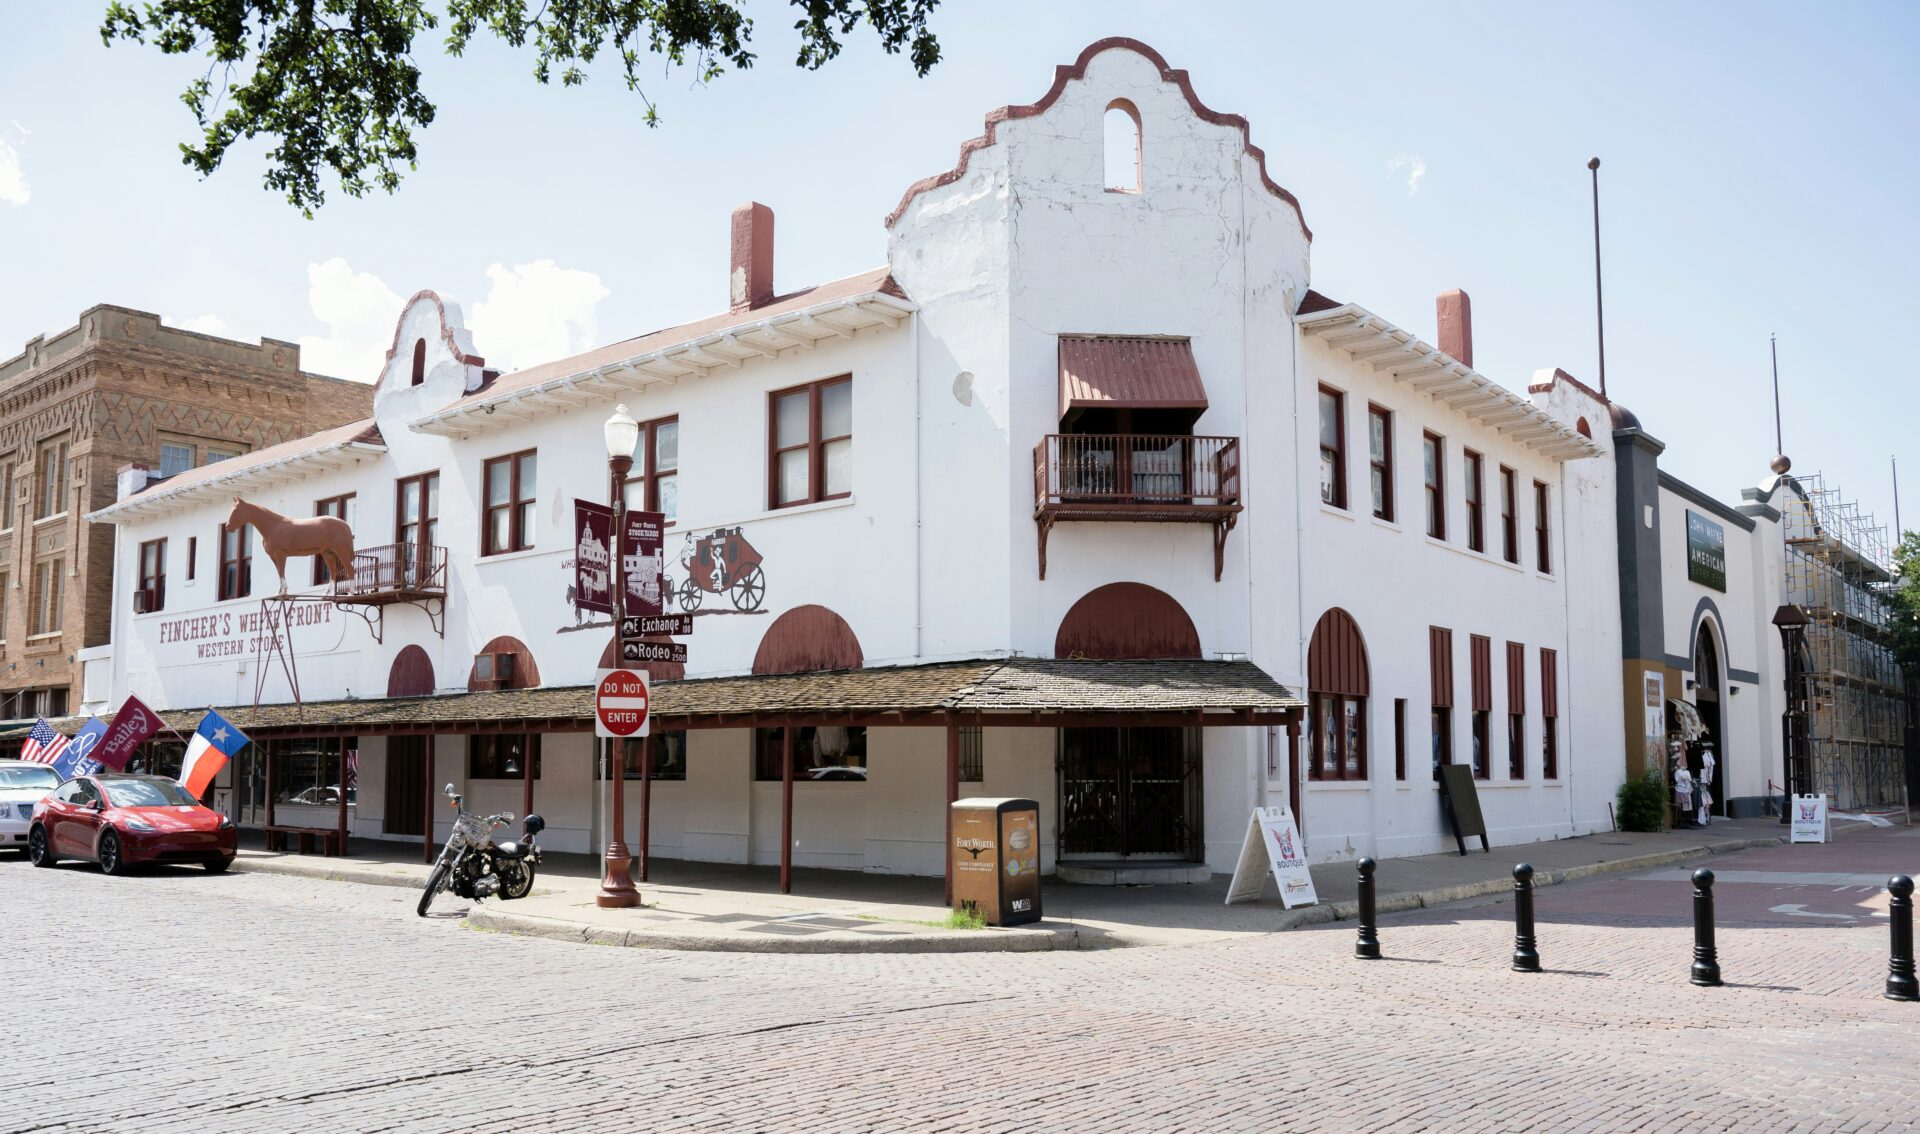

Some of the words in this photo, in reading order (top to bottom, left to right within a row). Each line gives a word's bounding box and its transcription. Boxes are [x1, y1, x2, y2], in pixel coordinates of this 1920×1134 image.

[1691, 547, 1725, 573] AMERICAN
[160, 612, 231, 644] FINCHER'S
[239, 608, 280, 633] WHITE
[287, 602, 333, 627] FRONT
[633, 618, 639, 633] E
[641, 617, 680, 635] Exchange
[683, 615, 690, 624] Av
[682, 625, 691, 634] 100
[197, 639, 244, 659] WESTERN
[250, 634, 285, 653] STORE
[638, 643, 670, 659] Rodeo
[672, 653, 687, 662] 2500
[604, 682, 618, 693] DO
[623, 683, 641, 694] NOT
[608, 712, 637, 723] ENTER
[102, 708, 148, 756] Bailey
[122, 738, 137, 753] HATS
[1277, 858, 1304, 869] BOUTIQUE
